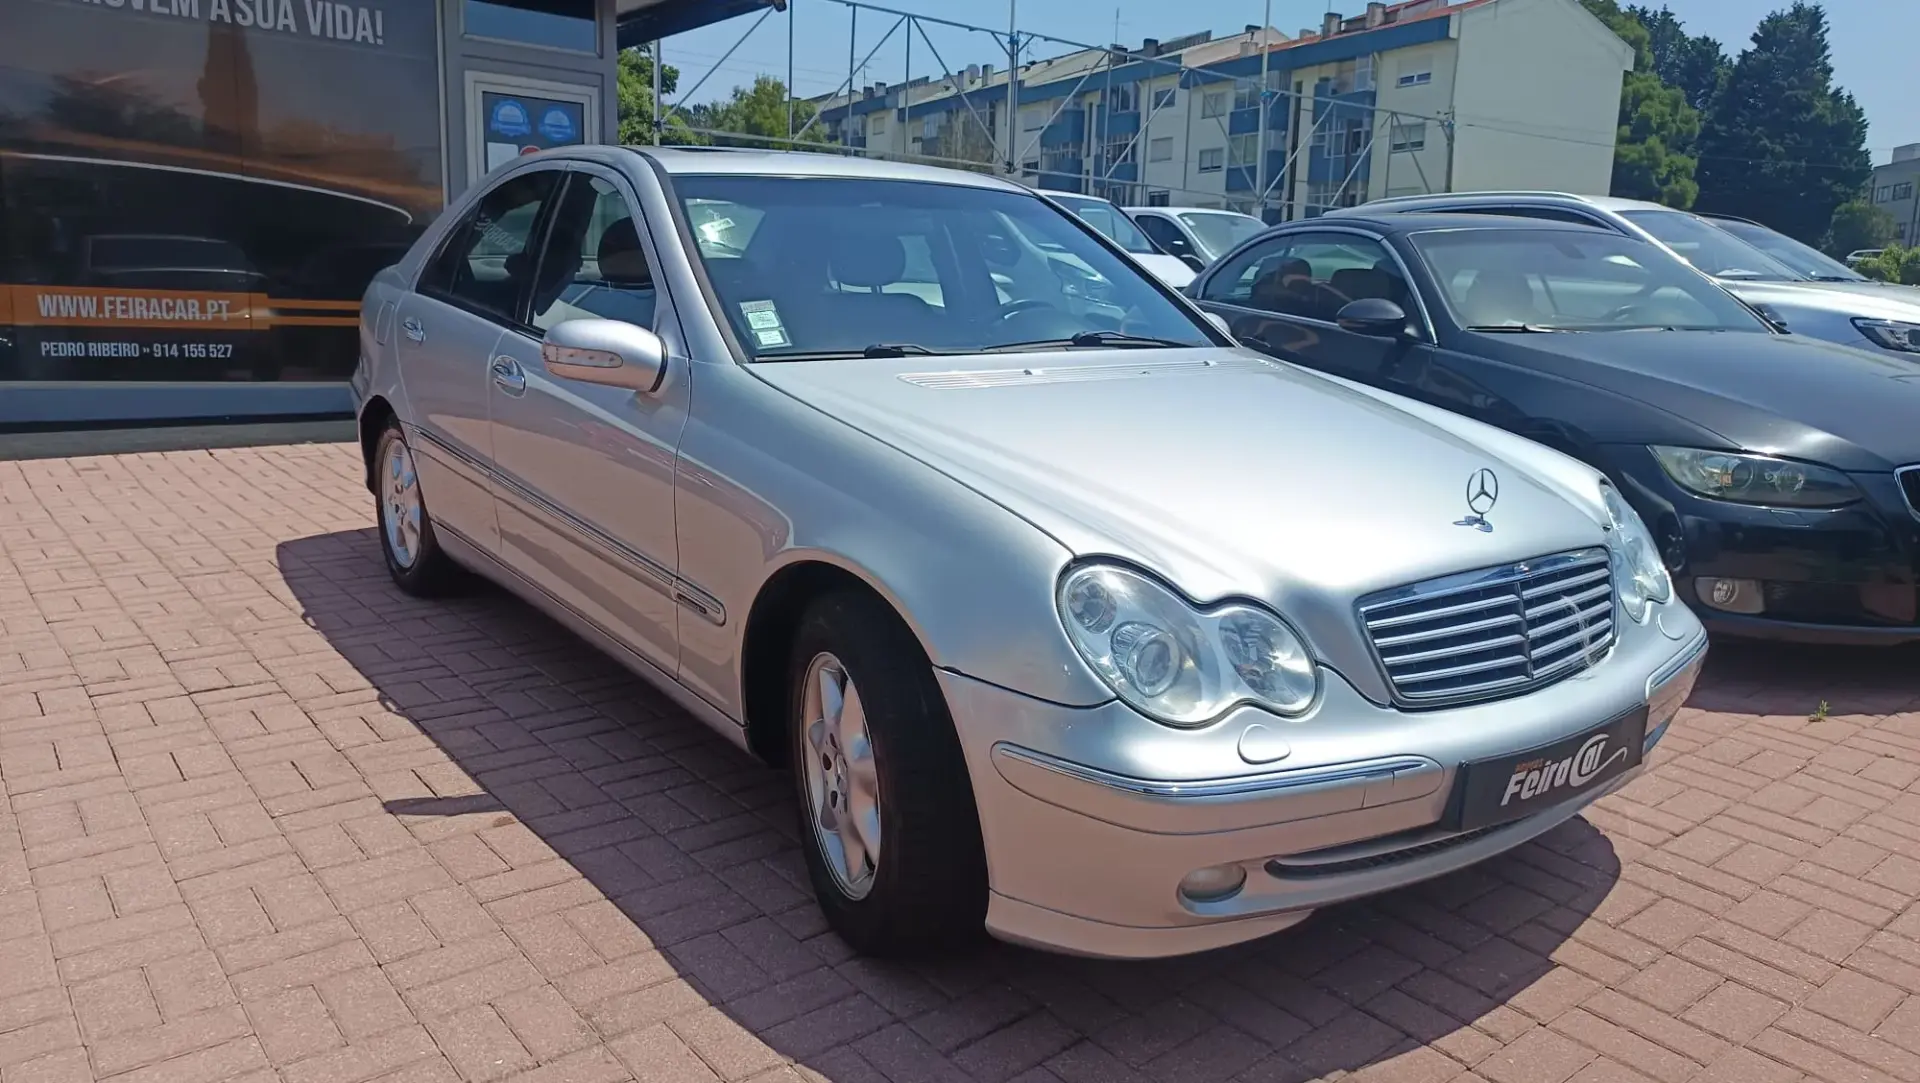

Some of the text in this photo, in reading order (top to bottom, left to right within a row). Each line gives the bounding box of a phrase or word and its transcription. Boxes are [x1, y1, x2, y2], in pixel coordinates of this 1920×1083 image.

[304, 0, 384, 45] VIDA!
[37, 294, 230, 321] WWW.FEIRACAR.PT
[41, 341, 85, 357] PEDRO
[87, 342, 140, 357] RIBEIRO
[153, 343, 179, 358] 914
[182, 343, 206, 358] 155
[209, 344, 233, 358] 527
